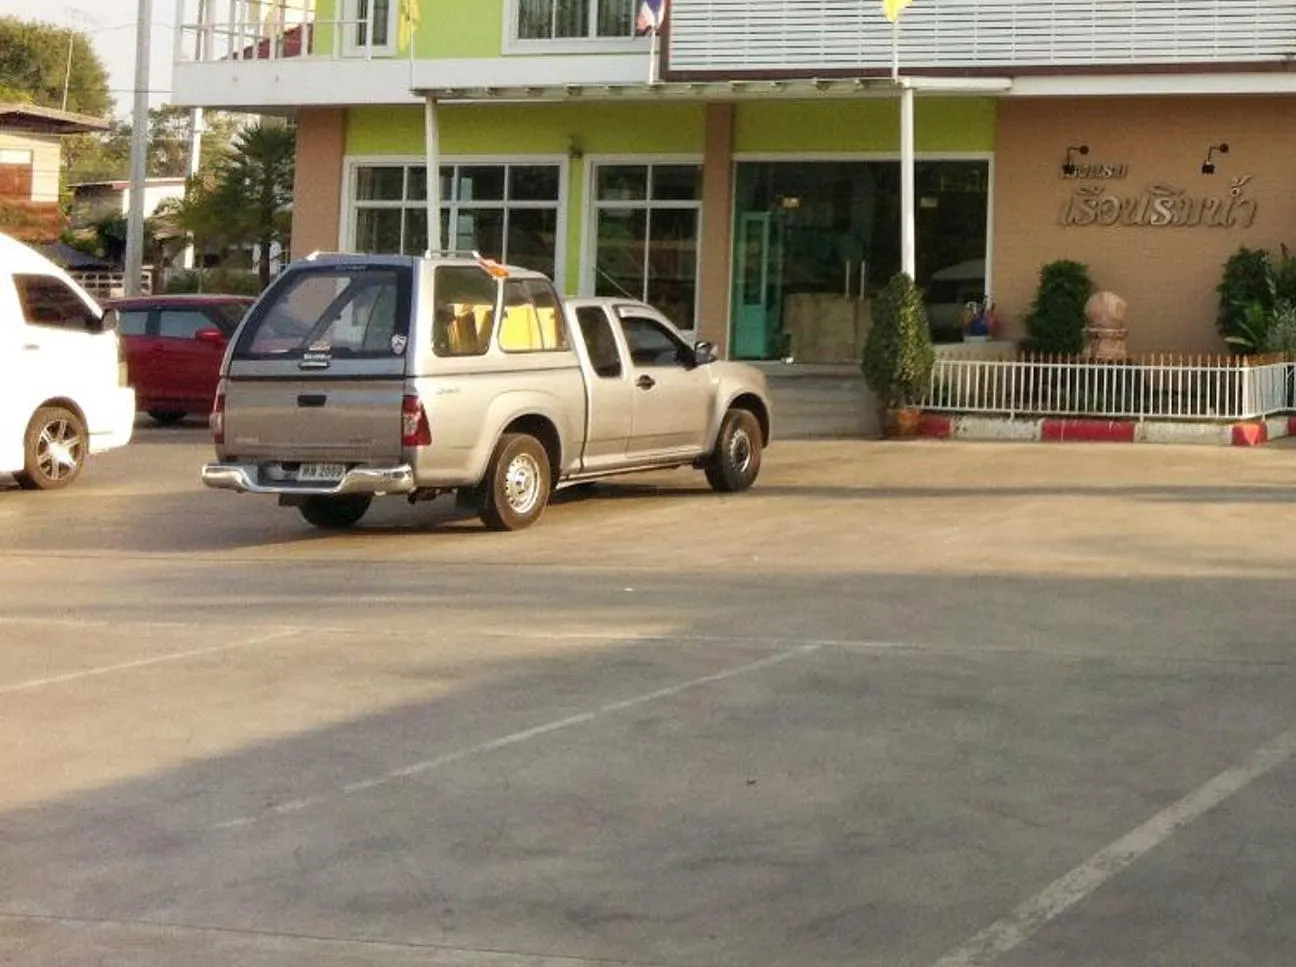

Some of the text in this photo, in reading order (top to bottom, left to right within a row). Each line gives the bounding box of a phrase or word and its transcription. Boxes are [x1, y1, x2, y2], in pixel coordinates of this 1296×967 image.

[1060, 175, 1257, 227] เรือนริมน้ำ
